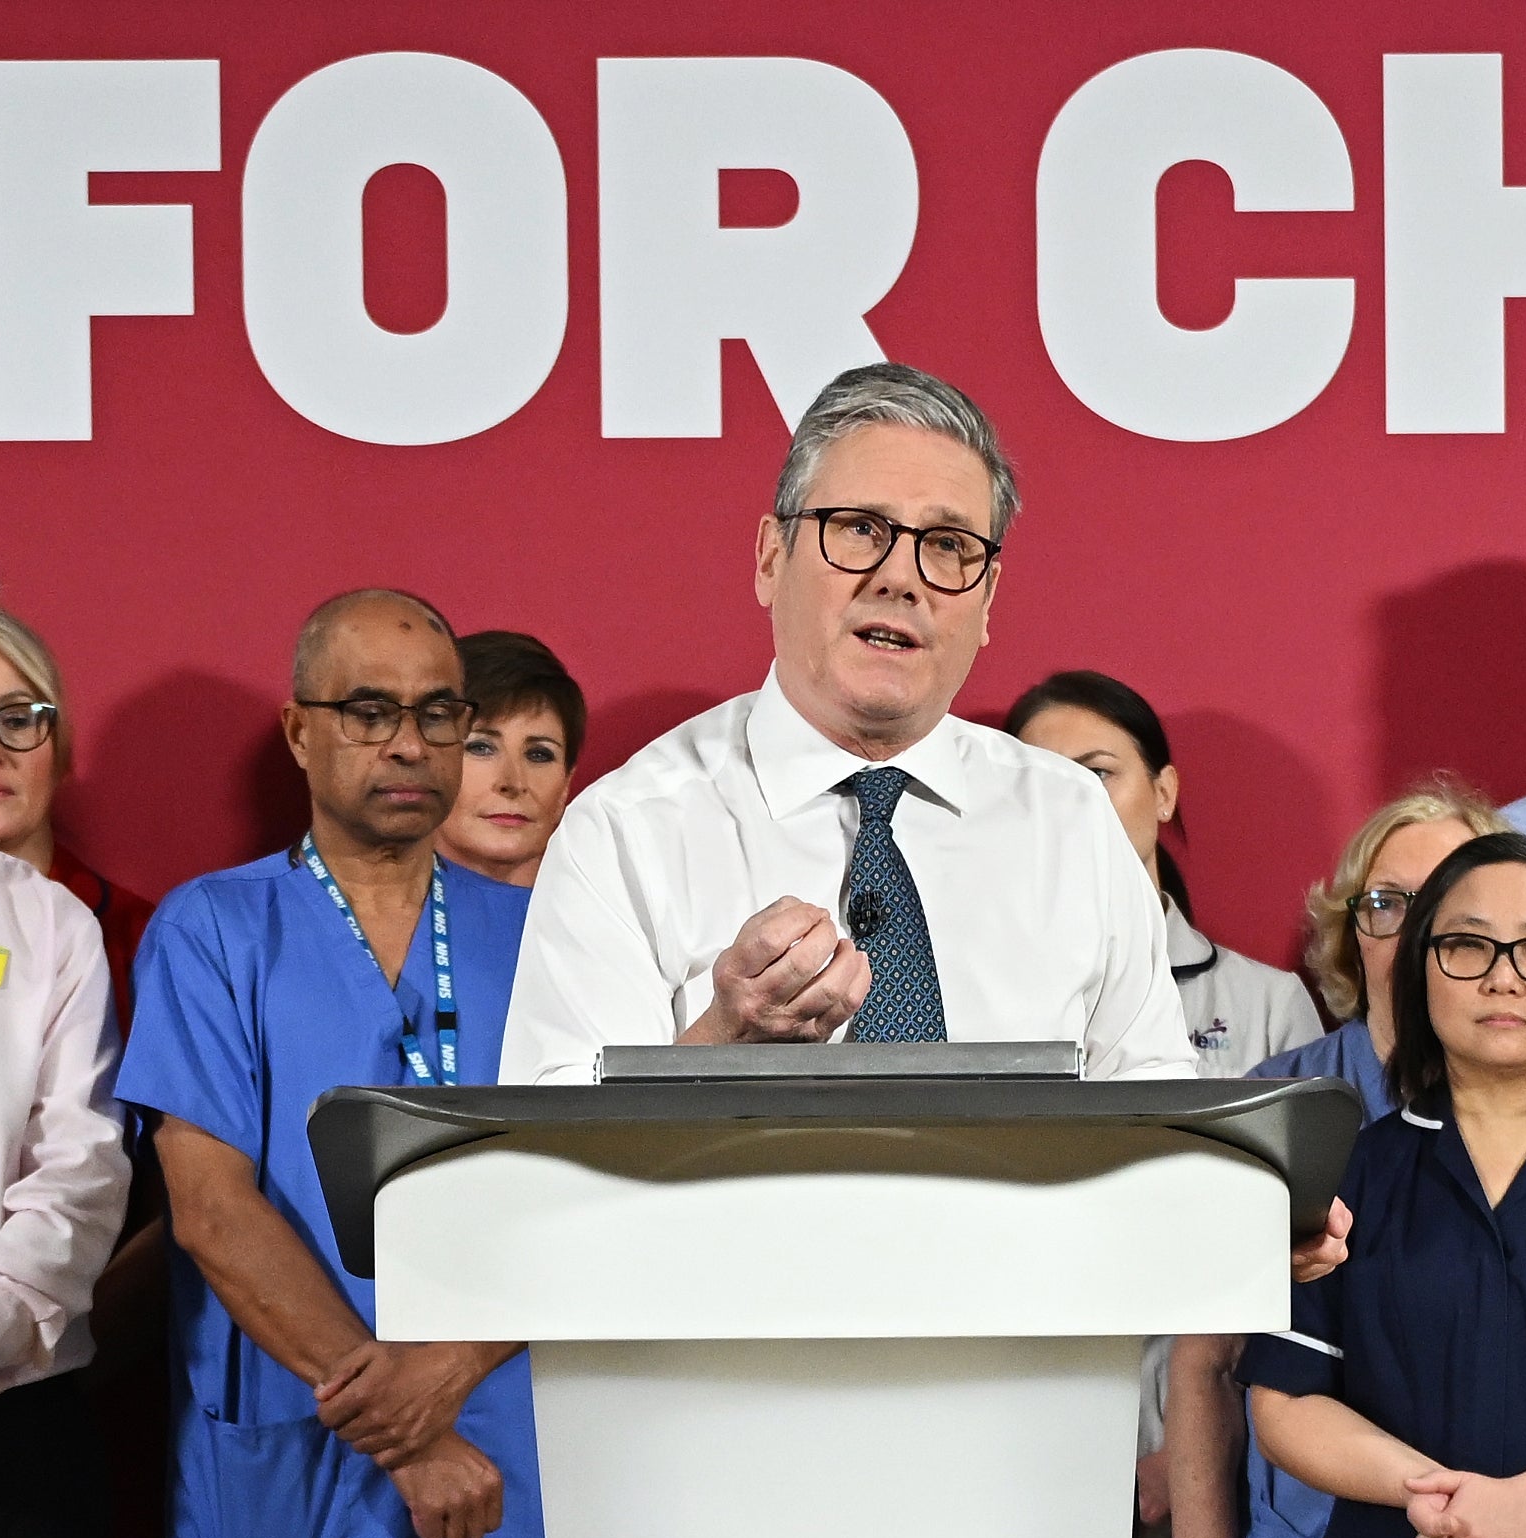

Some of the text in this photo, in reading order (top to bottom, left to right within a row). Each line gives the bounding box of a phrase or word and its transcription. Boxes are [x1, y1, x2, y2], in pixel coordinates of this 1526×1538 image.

[307, 855, 328, 880] NHS
[434, 910, 447, 936] NHS
[435, 942, 450, 967] NHS
[437, 974, 453, 999] NHS
[406, 1051, 432, 1078] NHS
[440, 1044, 456, 1073] NHS
